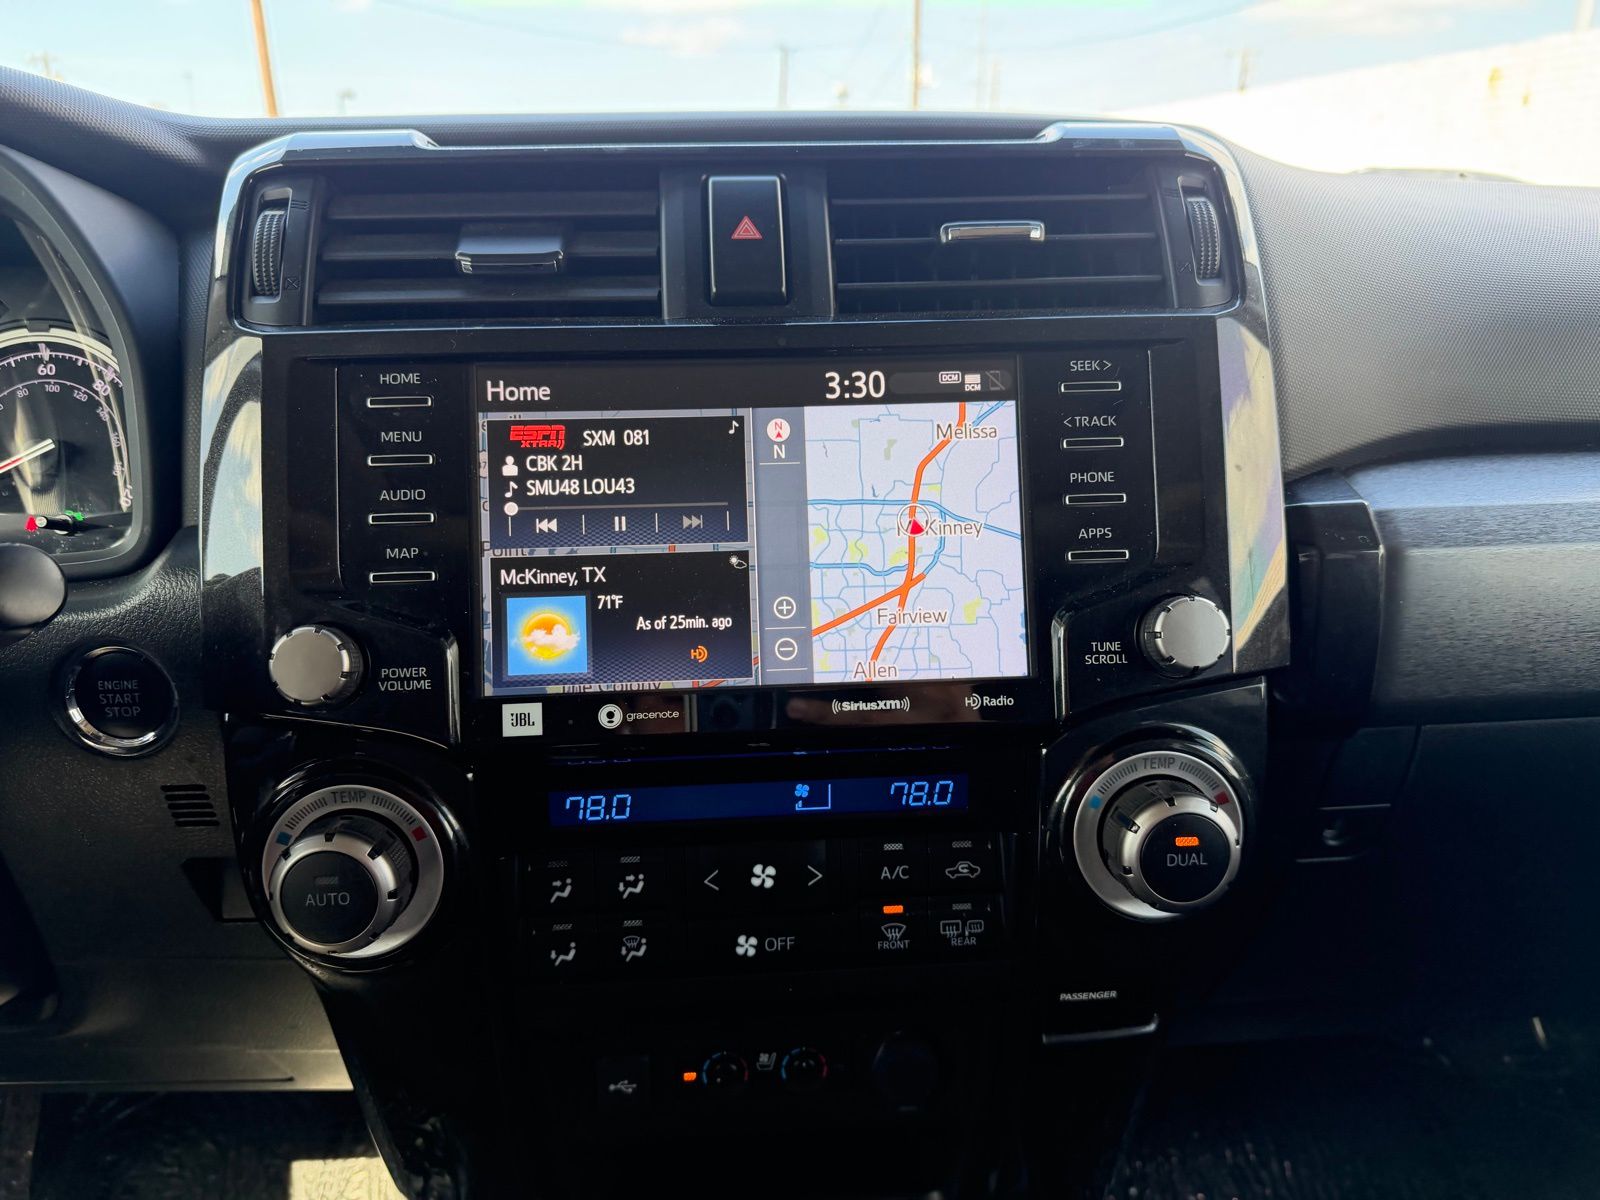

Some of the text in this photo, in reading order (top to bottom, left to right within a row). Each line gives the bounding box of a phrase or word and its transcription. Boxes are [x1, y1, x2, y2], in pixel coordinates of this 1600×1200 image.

[37, 364, 56, 376] 60
[1070, 360, 1101, 371] SEEK
[379, 373, 421, 385] HOME
[942, 373, 958, 382] DCM
[44, 384, 61, 393] 100
[92, 379, 111, 396] 80
[486, 380, 551, 401] Home
[825, 371, 886, 399] 3:30
[965, 383, 981, 391] DCM
[17, 388, 29, 398] 80
[73, 389, 89, 402] 120
[1074, 415, 1117, 427] TRACK
[381, 431, 422, 442] MENU
[510, 424, 565, 440] ESPN
[583, 430, 650, 446] SXM 081
[936, 423, 998, 441] Melissa
[773, 444, 786, 459] N
[526, 456, 583, 472] CBK 2H
[1070, 472, 1115, 483] PHONE
[526, 478, 635, 496] SMU48 LOU43
[380, 489, 426, 501] AUDIO
[897, 519, 983, 538] MKinney
[1078, 528, 1112, 539] APPS
[386, 548, 419, 559] MAP
[500, 566, 606, 586] McKinney, TX
[636, 614, 732, 631] As of 25min. ago
[877, 608, 947, 625] Fairview
[1091, 642, 1121, 653] TUNE
[1085, 655, 1128, 665] SCROLL
[381, 667, 427, 679] POWER
[853, 661, 898, 679] Allen
[98, 680, 139, 690] ENGINE
[378, 680, 432, 692] VOLUME
[99, 693, 141, 704] START
[983, 696, 1014, 707] Radio
[104, 706, 141, 718] STOP
[626, 709, 680, 721] gracenote
[510, 713, 535, 727] JBL
[1143, 757, 1176, 770] TEMP
[331, 791, 367, 805] TEMP
[891, 781, 954, 807] 78.0
[566, 794, 632, 820] 78.0
[1166, 852, 1208, 867] DUAL
[880, 865, 910, 880] A/C
[305, 892, 350, 907] AUTO
[765, 937, 795, 951] OFF
[877, 940, 910, 950] FRONT
[951, 937, 977, 946] REAR
[1060, 990, 1117, 1001] PASSENGER
